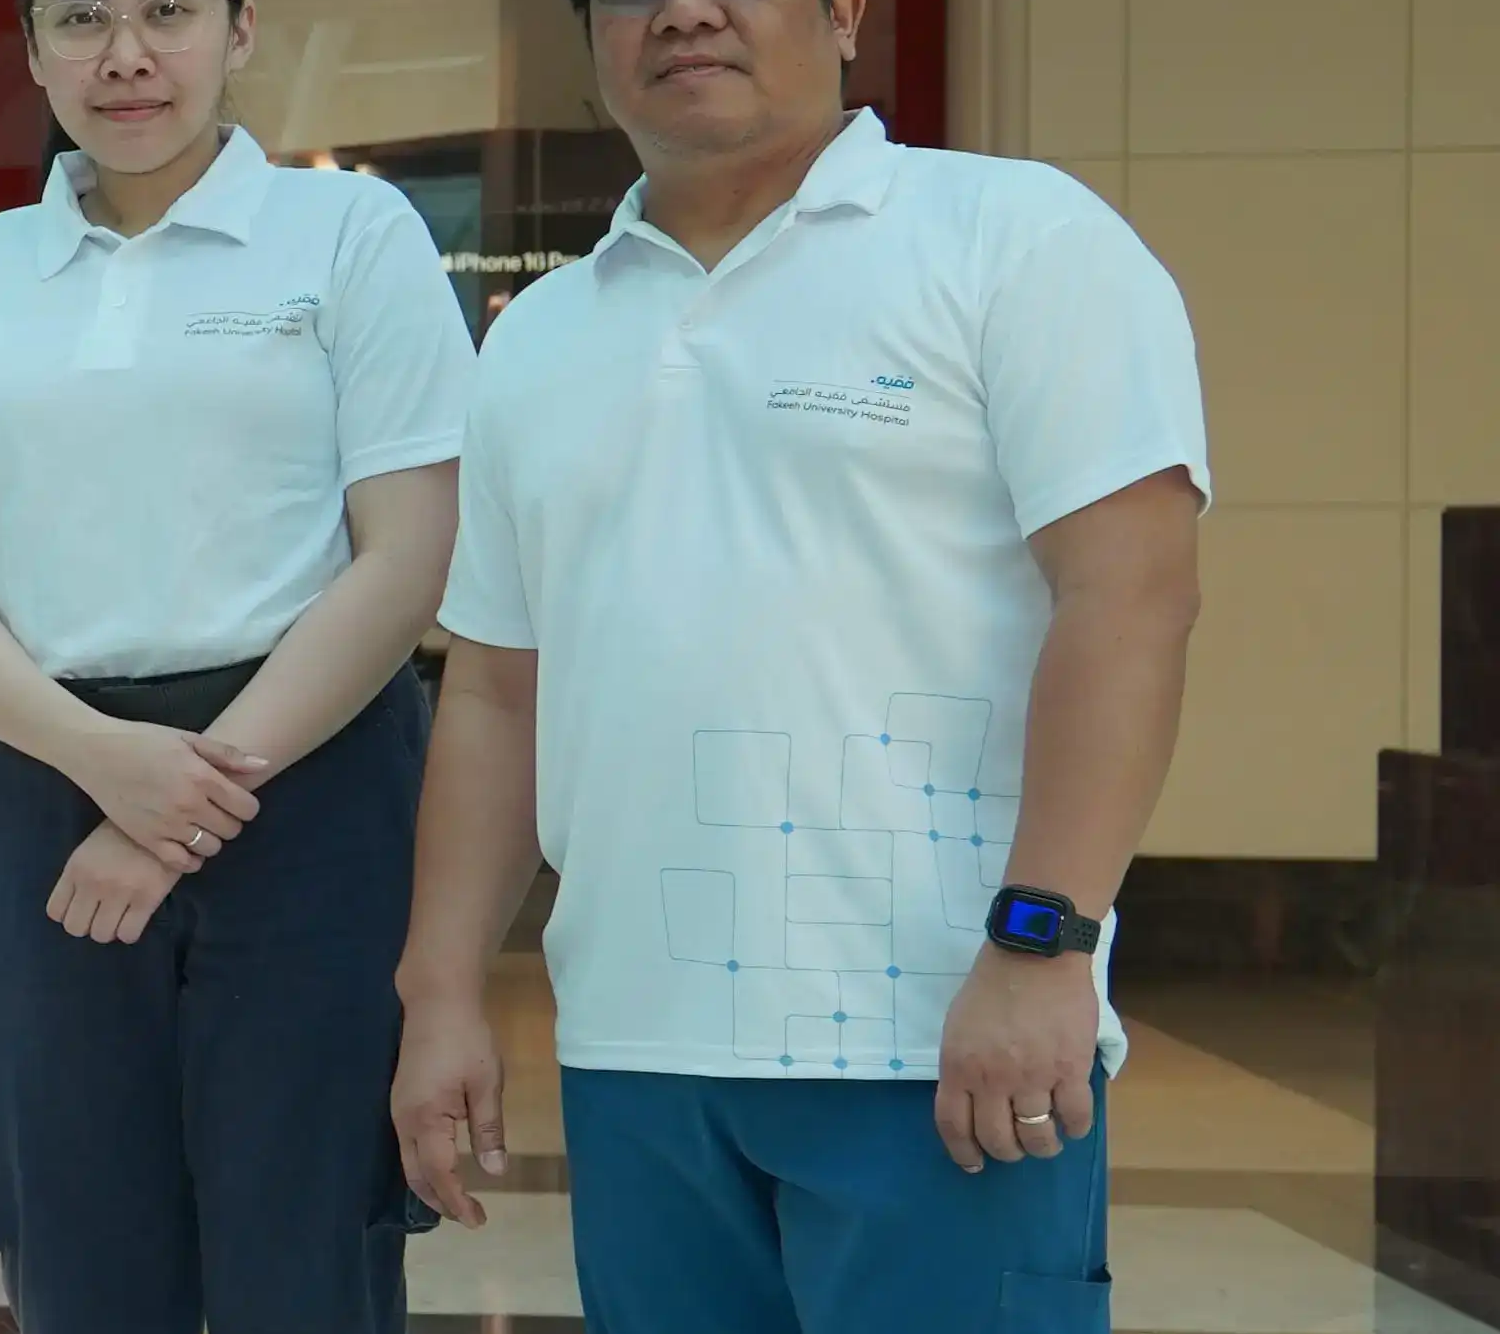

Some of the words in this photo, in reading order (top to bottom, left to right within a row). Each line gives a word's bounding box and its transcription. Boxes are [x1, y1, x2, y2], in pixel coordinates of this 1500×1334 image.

[766, 399, 801, 411] Fakeeh
[803, 402, 858, 419] University
[860, 410, 910, 427] Hospital
